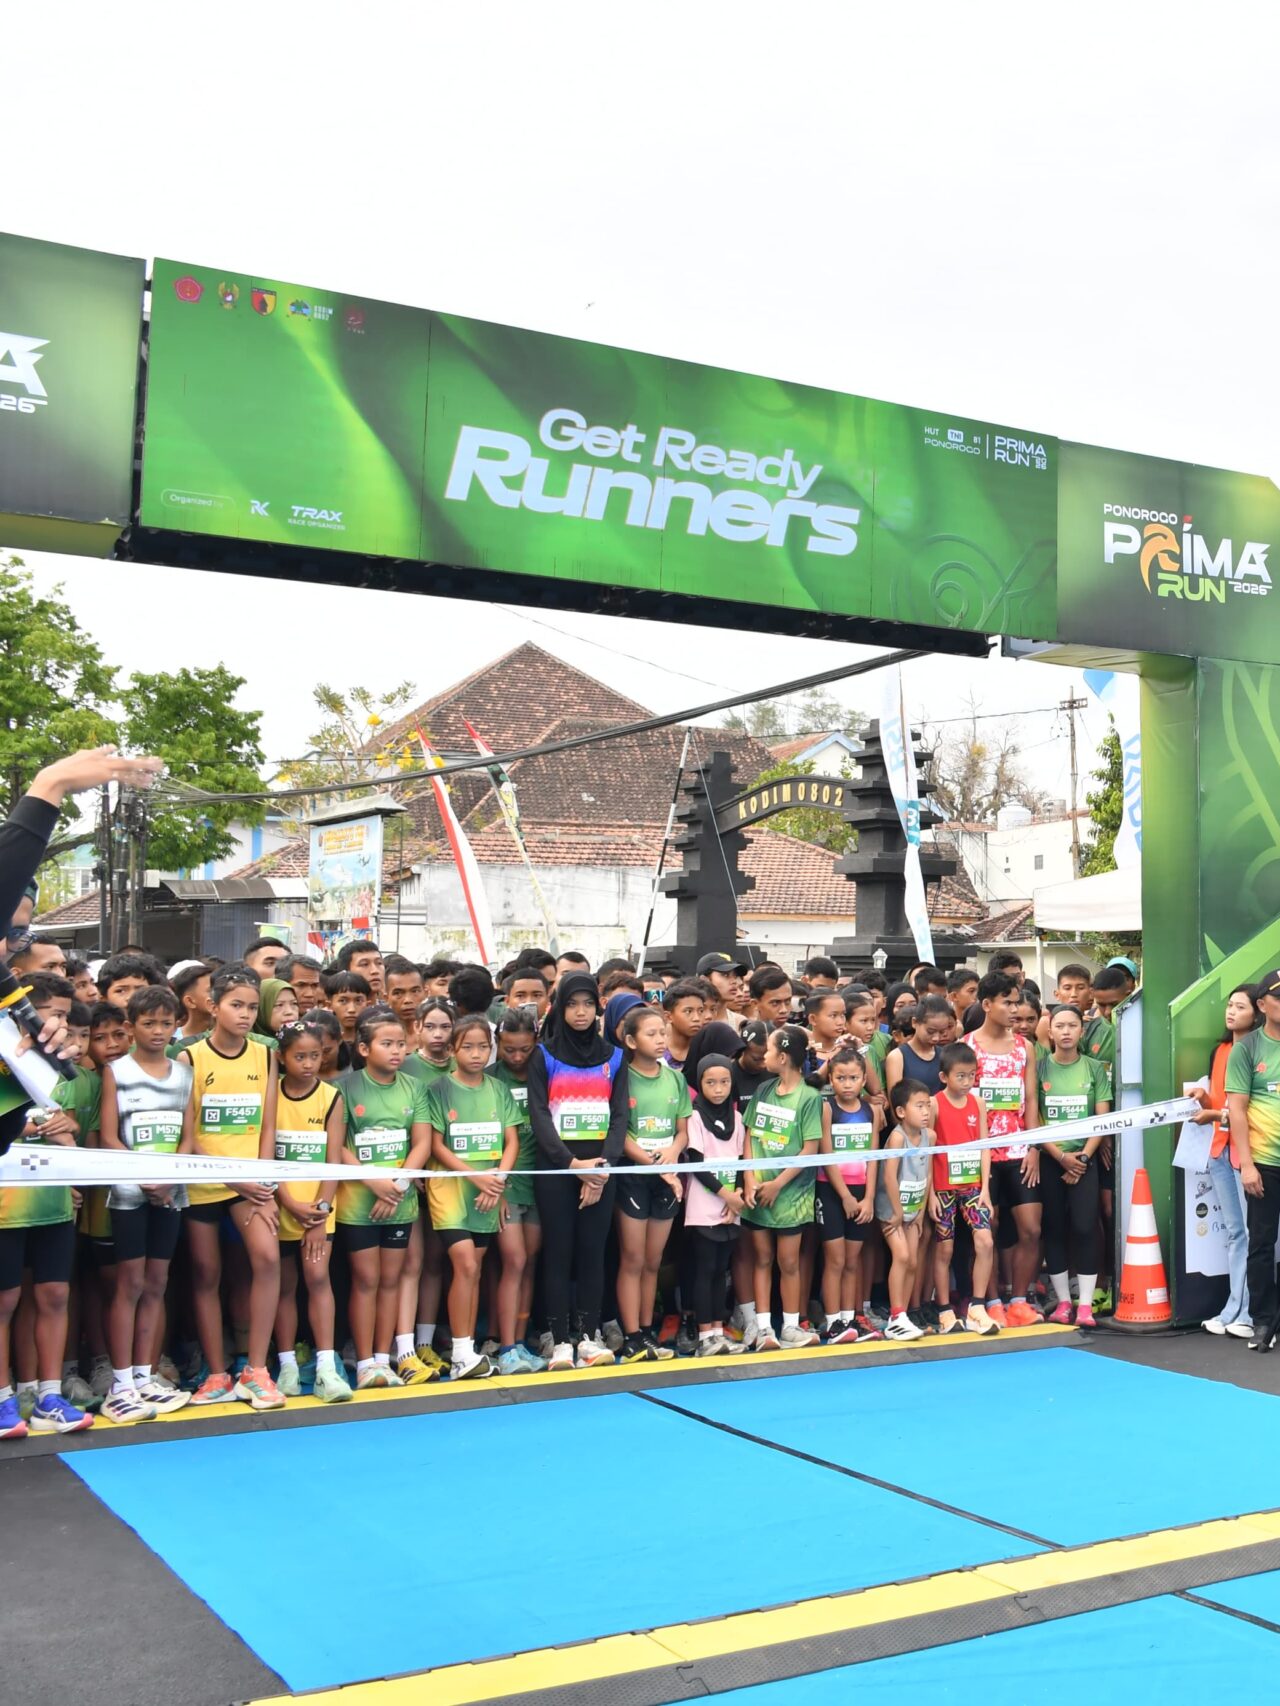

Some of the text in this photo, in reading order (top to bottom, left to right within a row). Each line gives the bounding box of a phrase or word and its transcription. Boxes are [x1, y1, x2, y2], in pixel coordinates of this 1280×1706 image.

[924, 426, 981, 444] HUT TNI 81
[539, 408, 823, 498] Get Ready
[994, 435, 1047, 457] PRIMA
[994, 449, 1030, 467] RUN
[444, 425, 860, 556] Runners
[169, 493, 213, 507] Organized
[291, 505, 343, 522] TRAX
[1103, 503, 1178, 525] PONOROGO
[287, 518, 346, 531] RACE ORGANIZER
[1157, 572, 1226, 603] RUN
[1228, 580, 1273, 596] 2026
[739, 782, 843, 819] KODIM 0802
[225, 1107, 257, 1117] F5457
[1061, 1105, 1085, 1113] F5644
[581, 1115, 605, 1123] F5501
[471, 1135, 498, 1144] F5795
[290, 1144, 321, 1154] F5426
[376, 1142, 404, 1154] F5076
